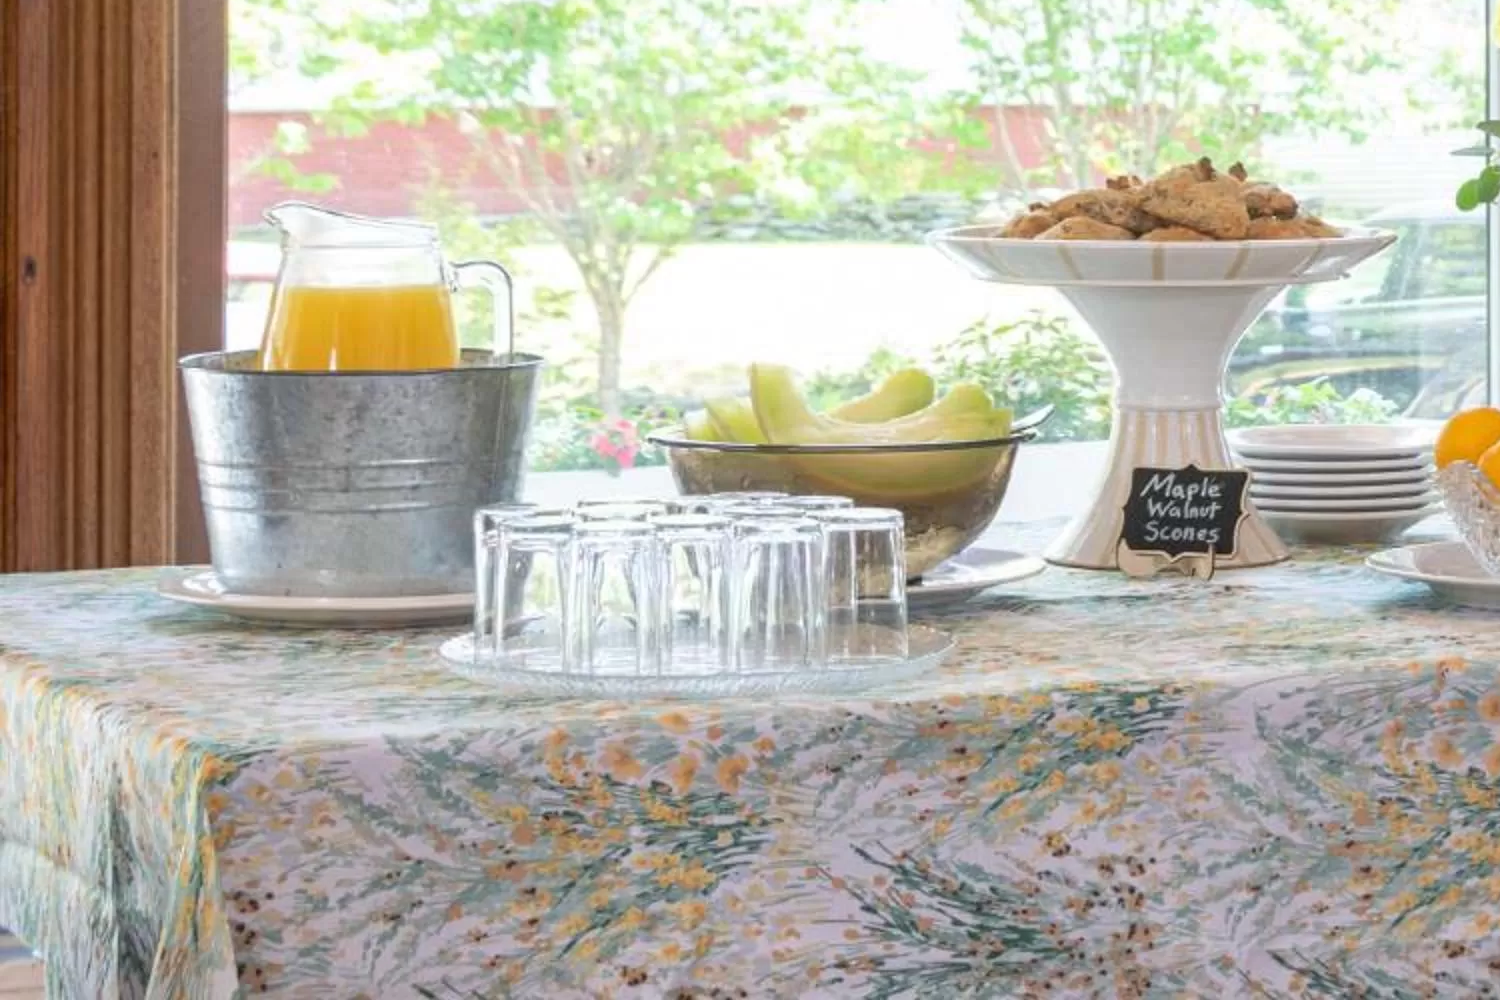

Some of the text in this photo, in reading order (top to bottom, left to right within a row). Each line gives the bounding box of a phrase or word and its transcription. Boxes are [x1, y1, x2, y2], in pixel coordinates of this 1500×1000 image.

[1140, 472, 1222, 501] Maple
[1147, 498, 1223, 519] Walnut
[1143, 520, 1221, 544] Scones
